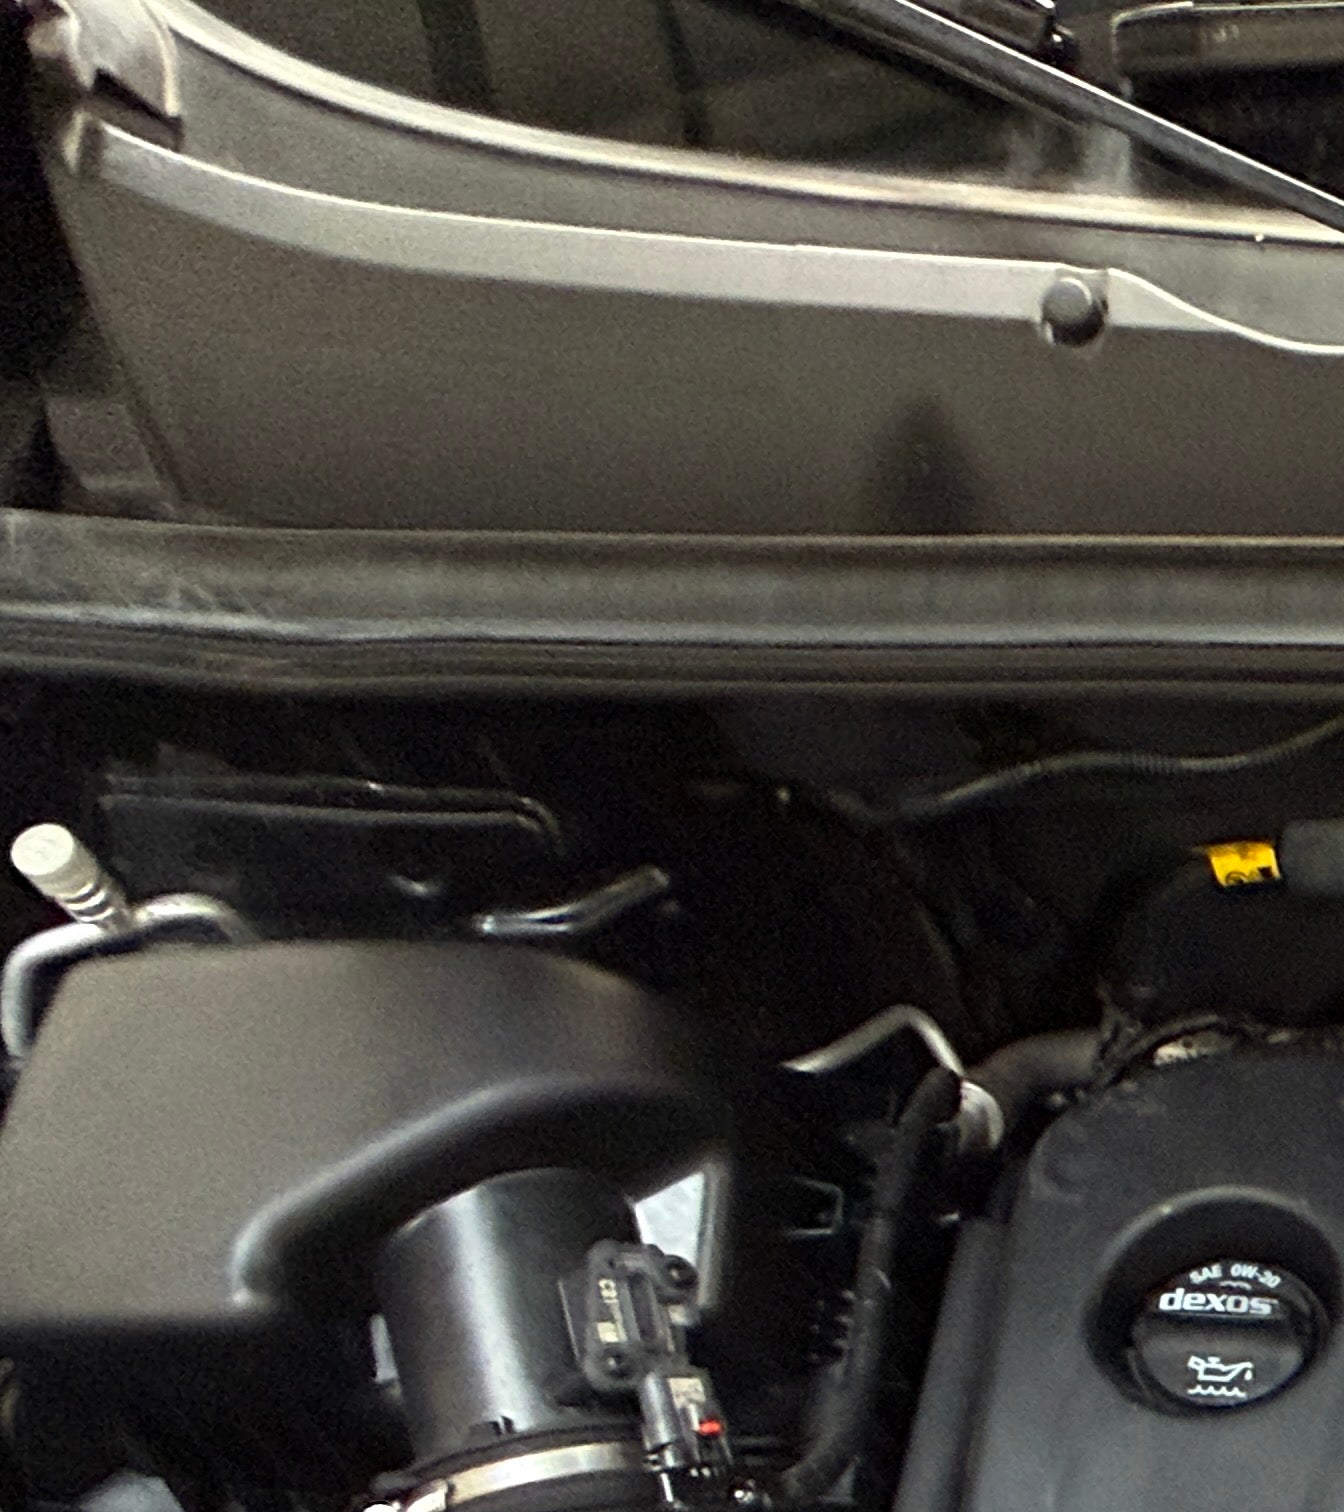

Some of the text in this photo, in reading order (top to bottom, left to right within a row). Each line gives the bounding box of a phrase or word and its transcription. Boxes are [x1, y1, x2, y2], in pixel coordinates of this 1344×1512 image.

[1189, 1263, 1282, 1289] SAE 0W-20
[1158, 1287, 1279, 1316] dexos
